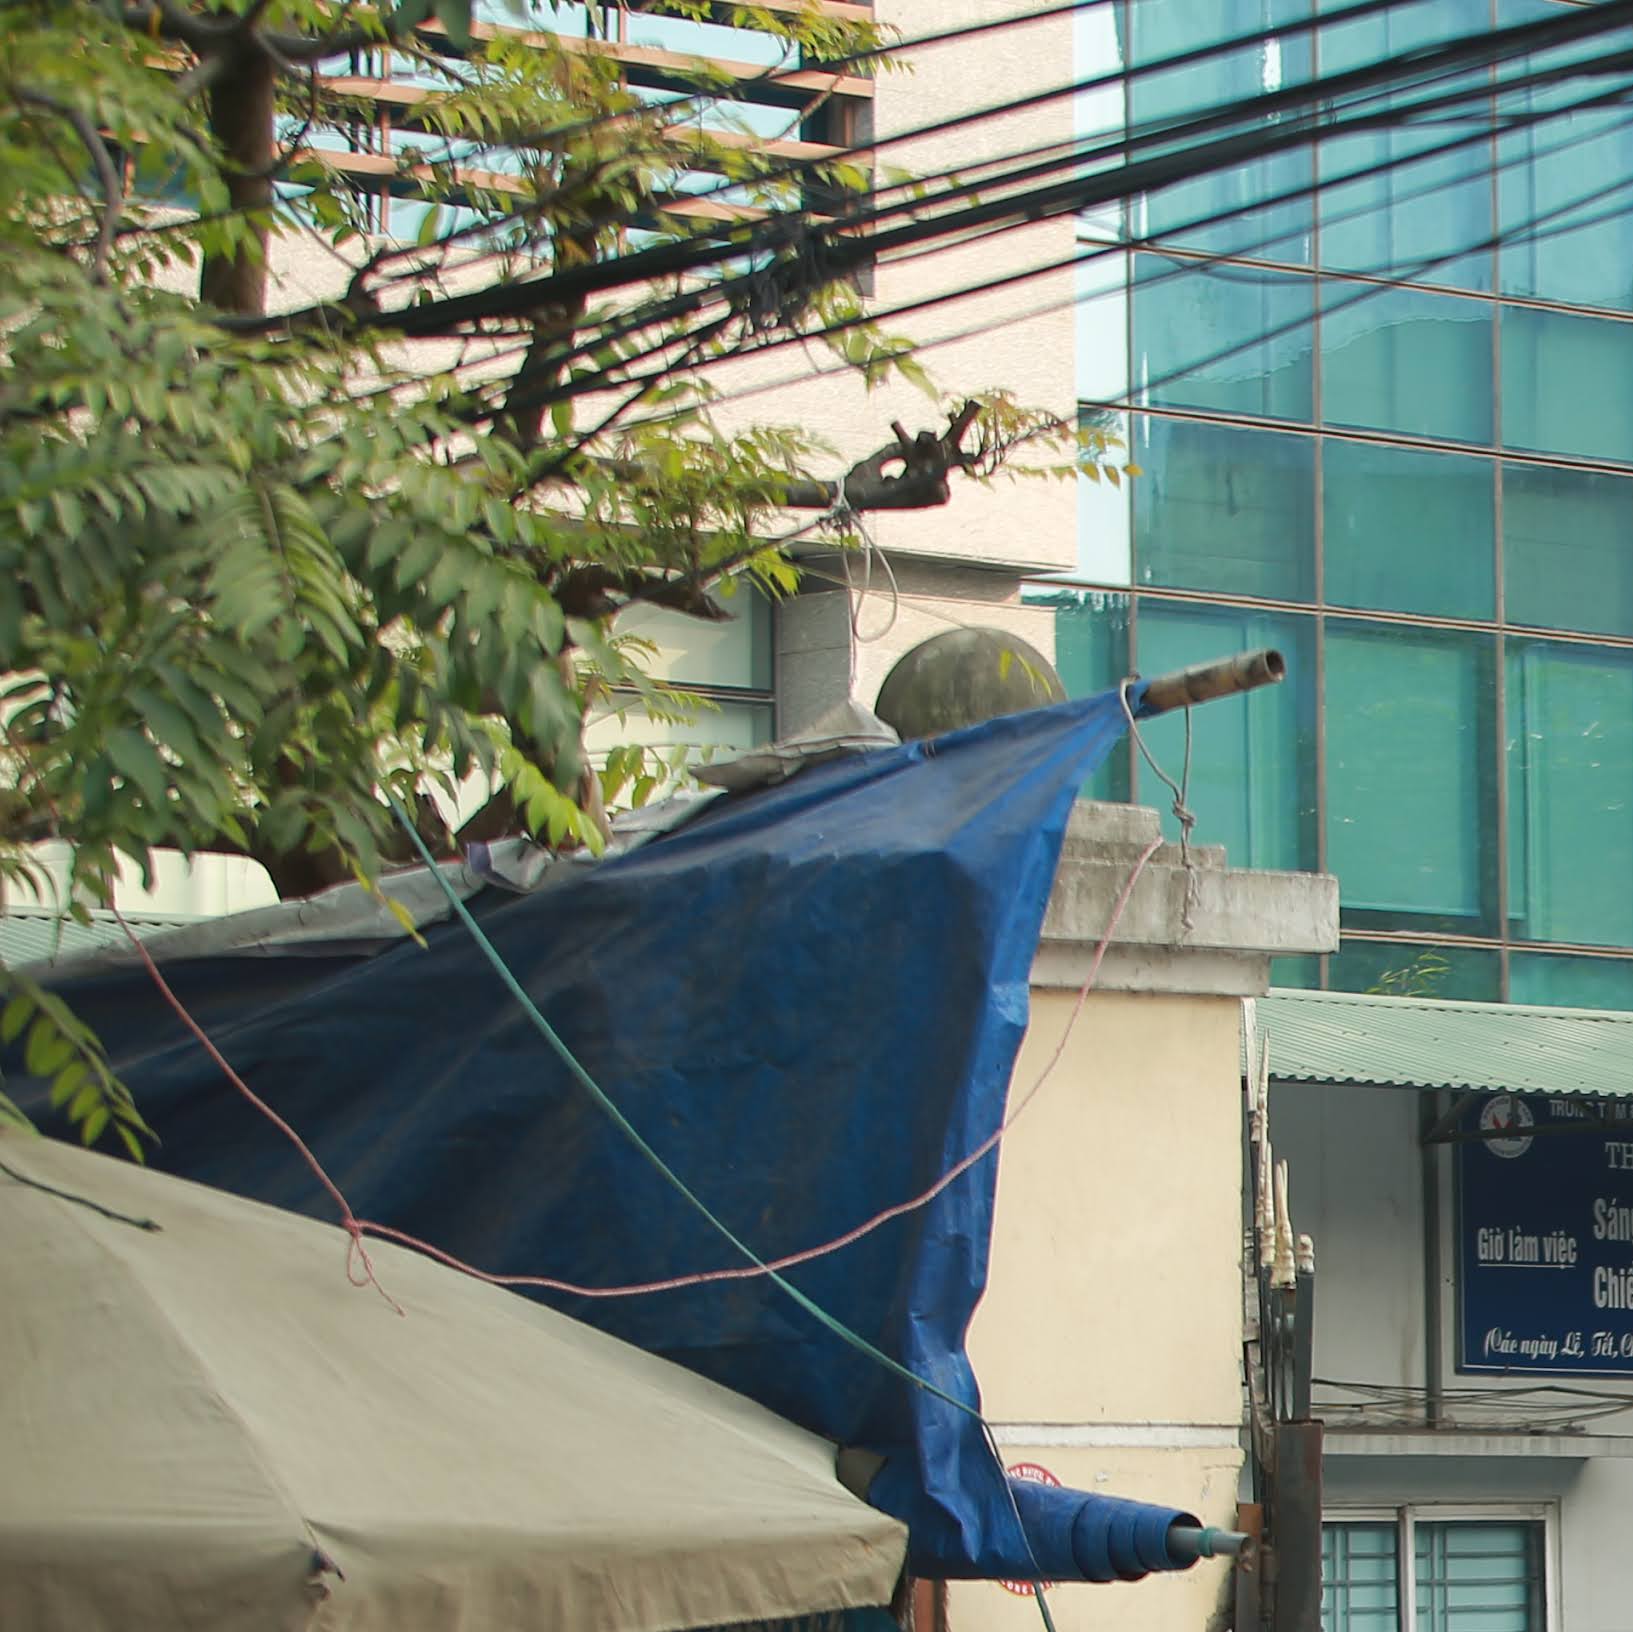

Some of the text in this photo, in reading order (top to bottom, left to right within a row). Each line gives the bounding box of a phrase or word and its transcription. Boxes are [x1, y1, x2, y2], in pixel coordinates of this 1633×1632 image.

[1508, 1225, 1539, 1263] làm
[1543, 1230, 1577, 1268] việc
[1520, 1335, 1558, 1360] ngày
